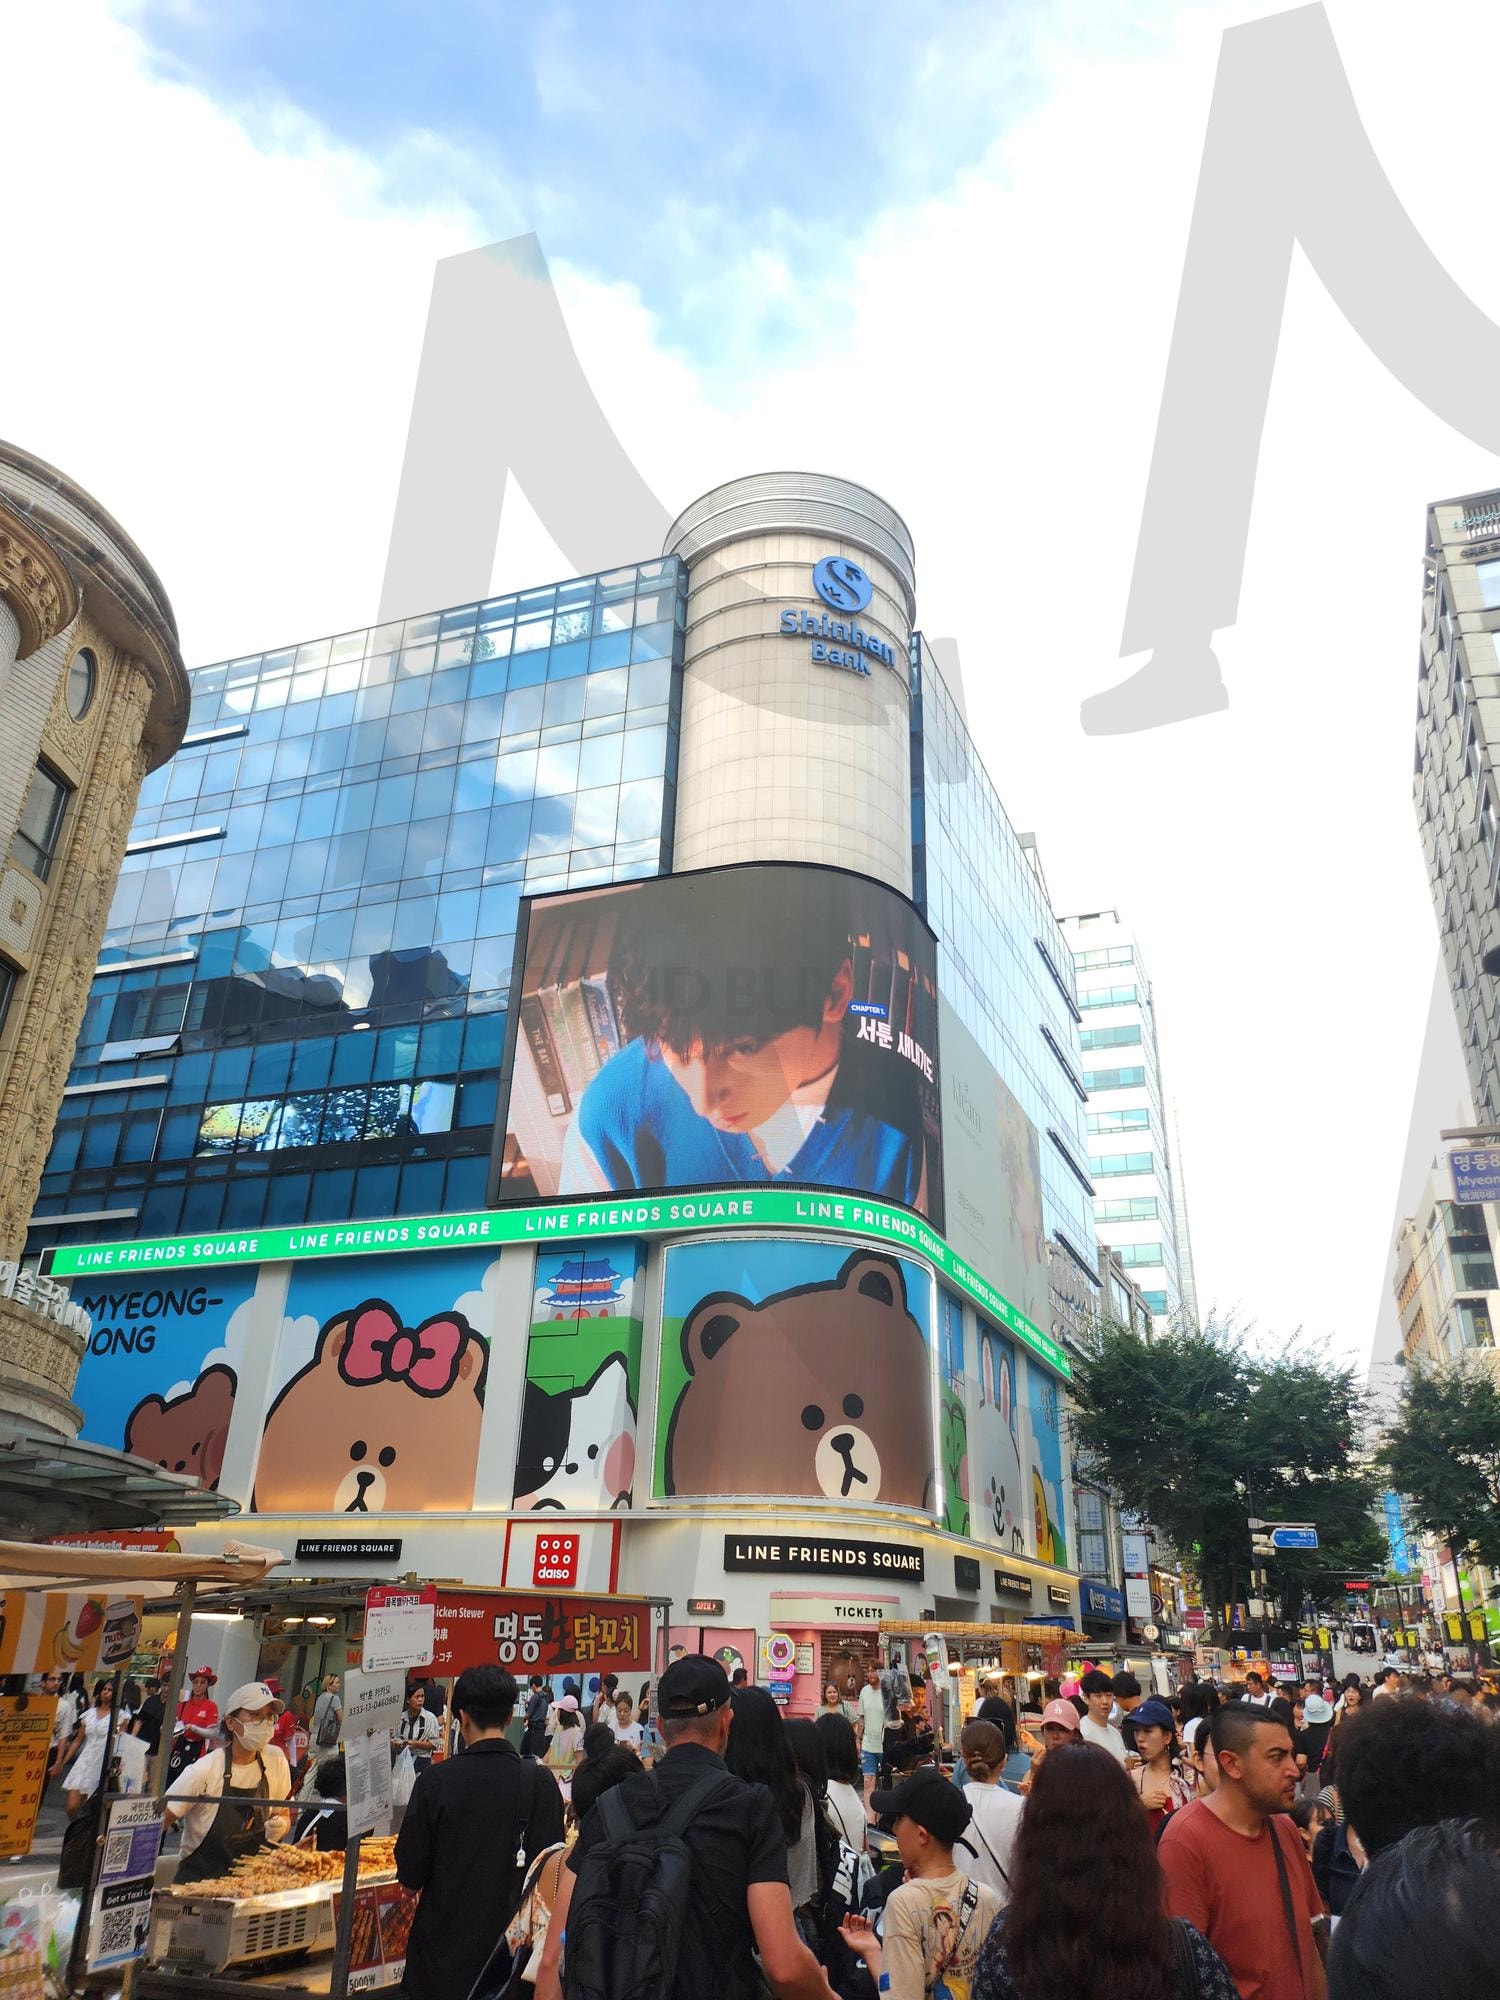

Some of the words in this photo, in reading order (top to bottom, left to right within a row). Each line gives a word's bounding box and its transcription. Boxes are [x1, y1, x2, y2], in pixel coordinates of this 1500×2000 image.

[779, 609, 897, 669] Shinhan
[811, 640, 872, 676] Bank
[856, 1016, 893, 1050] 서툰
[525, 1214, 570, 1231] LINE
[577, 1207, 661, 1227] FRIENDS
[669, 1200, 753, 1220] SQUARE
[289, 1233, 328, 1250] LINE
[334, 1228, 409, 1246] FRIENDS
[417, 1221, 491, 1240] SQUARE
[796, 1201, 845, 1220] LINE
[853, 1208, 916, 1239] FRIENDS
[918, 1229, 945, 1262] SQUARE
[77, 1251, 113, 1266] LINE
[118, 1245, 185, 1263] FRIENDS
[192, 1239, 259, 1257] SQUARE
[82, 1287, 224, 1323] MYEONG-
[85, 1325, 156, 1356] ONG
[301, 1544, 320, 1552] LINE
[322, 1544, 358, 1552] FRIENDS
[360, 1544, 394, 1552] SQUARE
[735, 1545, 780, 1561] LINE
[789, 1547, 867, 1565] FRIENDS
[873, 1552, 921, 1570] SQUARE
[538, 1566, 569, 1579] daiso
[459, 1607, 485, 1618] Stewer
[835, 1606, 883, 1618] TICKETS
[494, 1612, 544, 1663] 명동
[574, 1613, 639, 1661] 닭꼬치
